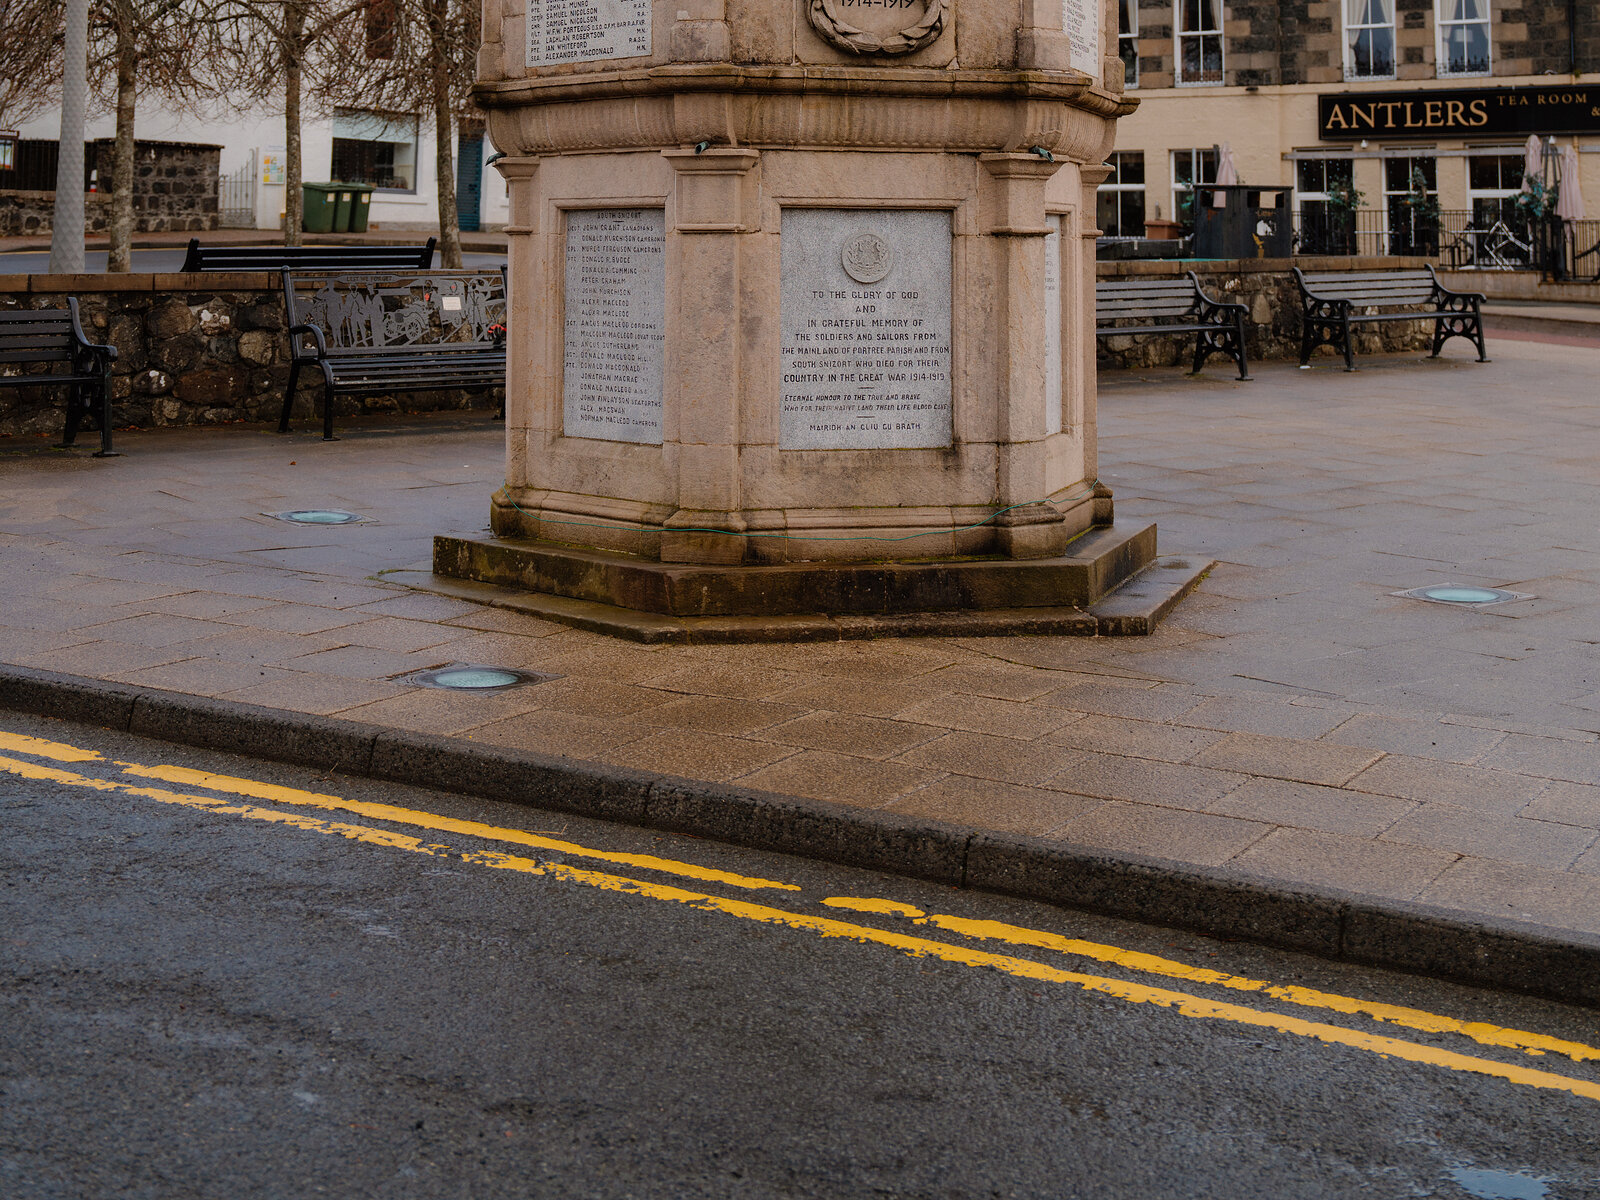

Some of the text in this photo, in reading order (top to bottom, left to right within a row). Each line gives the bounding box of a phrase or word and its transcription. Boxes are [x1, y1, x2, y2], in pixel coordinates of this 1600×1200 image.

[546, 3, 560, 12] JOHN
[570, 0, 589, 8] MUNRO
[570, 8, 598, 17] NICOLSON
[546, 20, 567, 28] SAMUEL
[570, 16, 598, 25] NICOLSON
[563, 24, 590, 33] PORTEOUS
[545, 35, 570, 44] LACHLAN
[572, 31, 605, 40] ROBERTSON
[557, 41, 587, 50] WHITEFORD
[545, 51, 577, 60] ALEXANDER
[580, 47, 614, 57] MACDONALD
[1497, 93, 1587, 106] TEA ROOM
[1326, 99, 1489, 129] ANTLERS
[812, 291, 919, 299] TO THE GLORY OF GOD
[855, 305, 876, 313] AND
[795, 333, 936, 341] THE SOLDIERS AND SAILORS FROM
[931, 346, 950, 354] FROM
[792, 360, 816, 369] SOUTH
[819, 360, 851, 368] SNIZORT
[917, 359, 939, 367] THEIR
[784, 373, 945, 383] COUNTRY IN THE GREAT WAR 1914-1919
